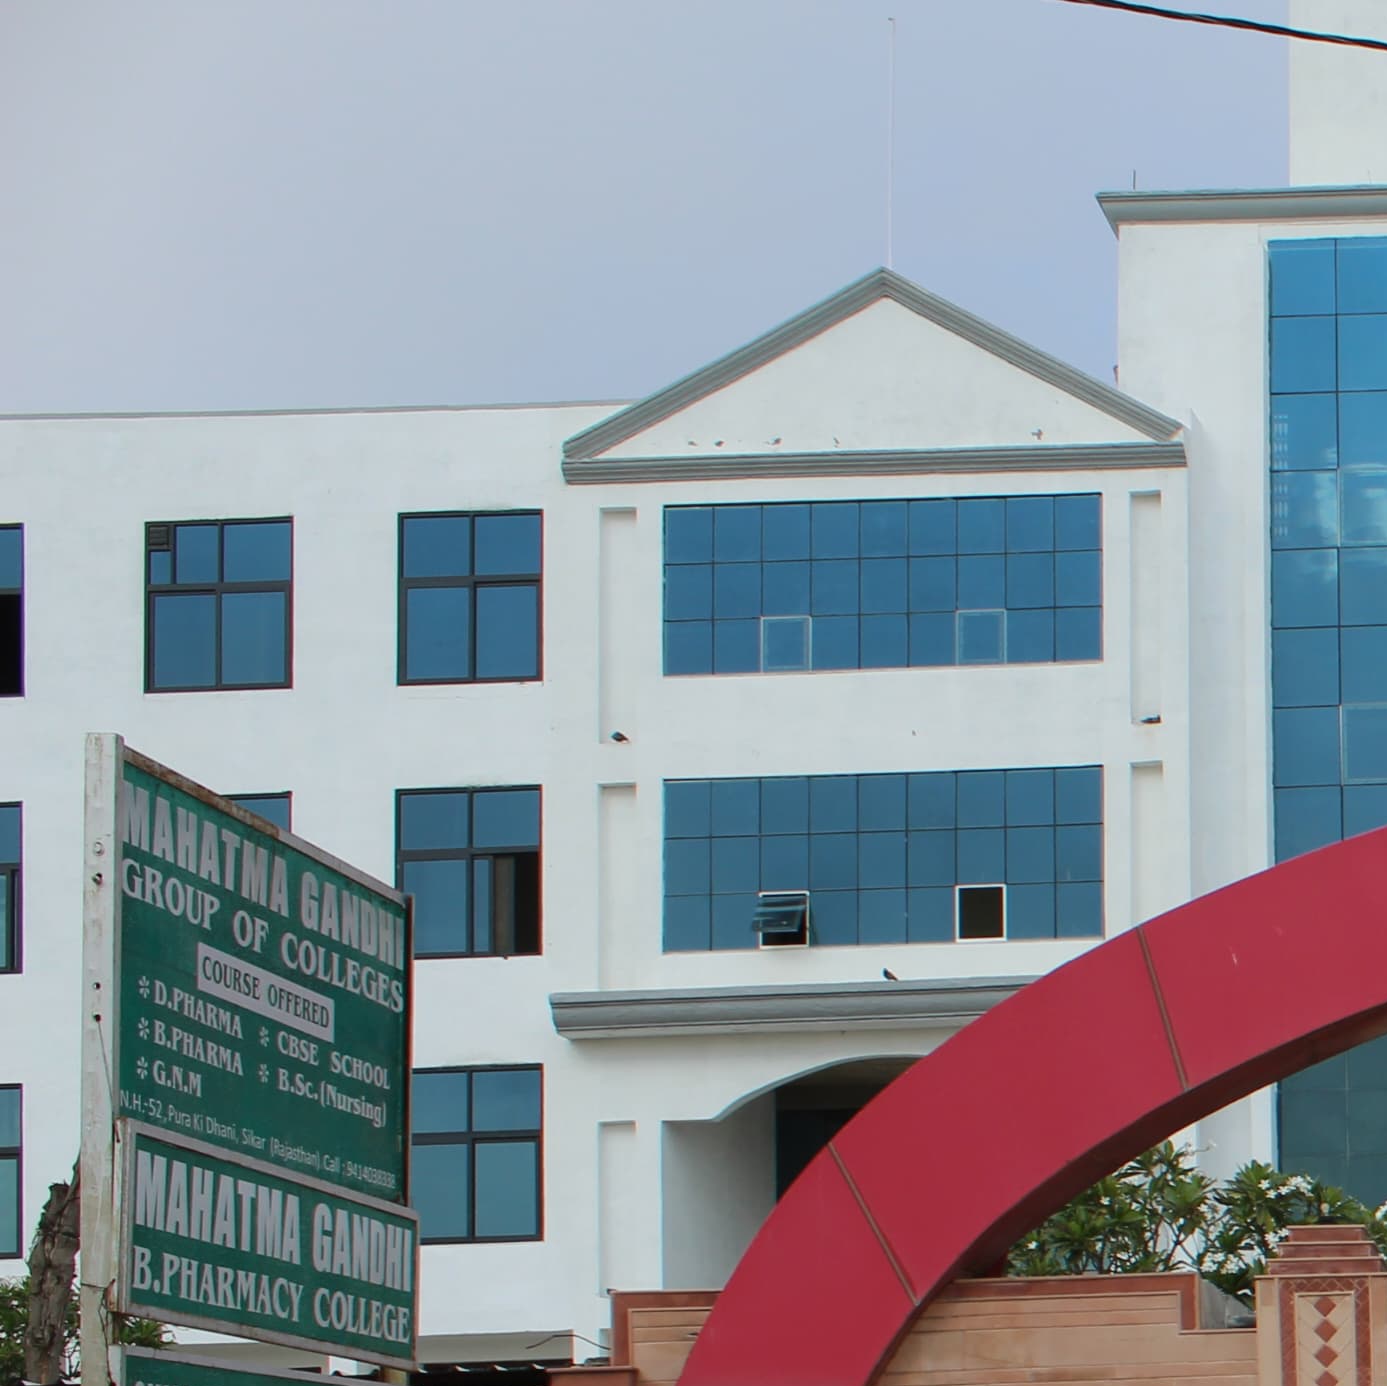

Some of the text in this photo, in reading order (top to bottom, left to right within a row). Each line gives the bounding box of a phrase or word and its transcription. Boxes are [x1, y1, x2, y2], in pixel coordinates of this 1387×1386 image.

[122, 780, 404, 971] MAHATMA GANDHI
[121, 858, 404, 1013] GROUP OF COLLEGES
[154, 980, 244, 1040] D.PHARMA
[203, 956, 330, 1028] COURSE OFFERED
[153, 1060, 201, 1097] G.N.M
[154, 1020, 244, 1076] B.PHARMA
[277, 1030, 391, 1090] CBSE SCHOOL
[242, 1127, 265, 1149] Sikar
[136, 1150, 412, 1292] MAHATMA GANDHI
[132, 1246, 410, 1343] B.PHARMACY COLLEGE
